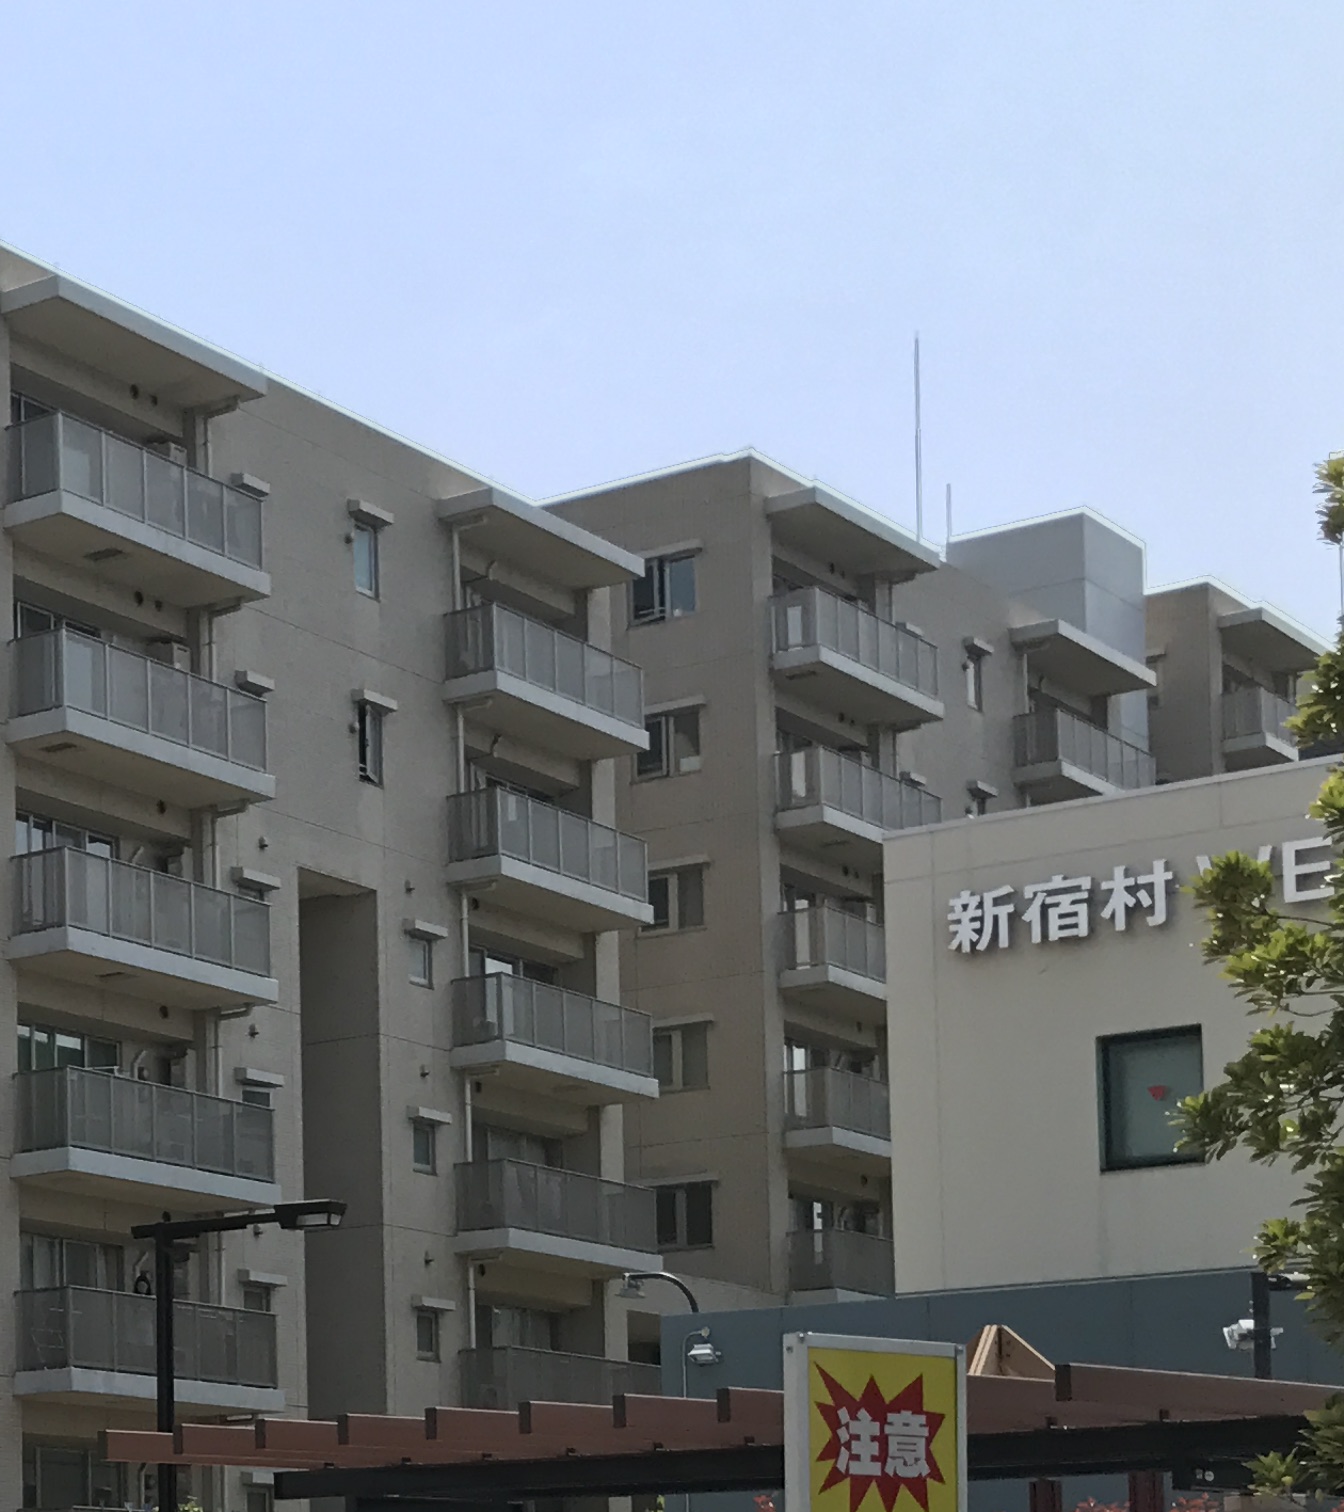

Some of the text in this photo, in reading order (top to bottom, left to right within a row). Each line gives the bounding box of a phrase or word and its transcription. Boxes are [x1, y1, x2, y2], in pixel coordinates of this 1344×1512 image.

[947, 858, 1174, 953] 新宿村
[836, 1407, 930, 1478] 注意
